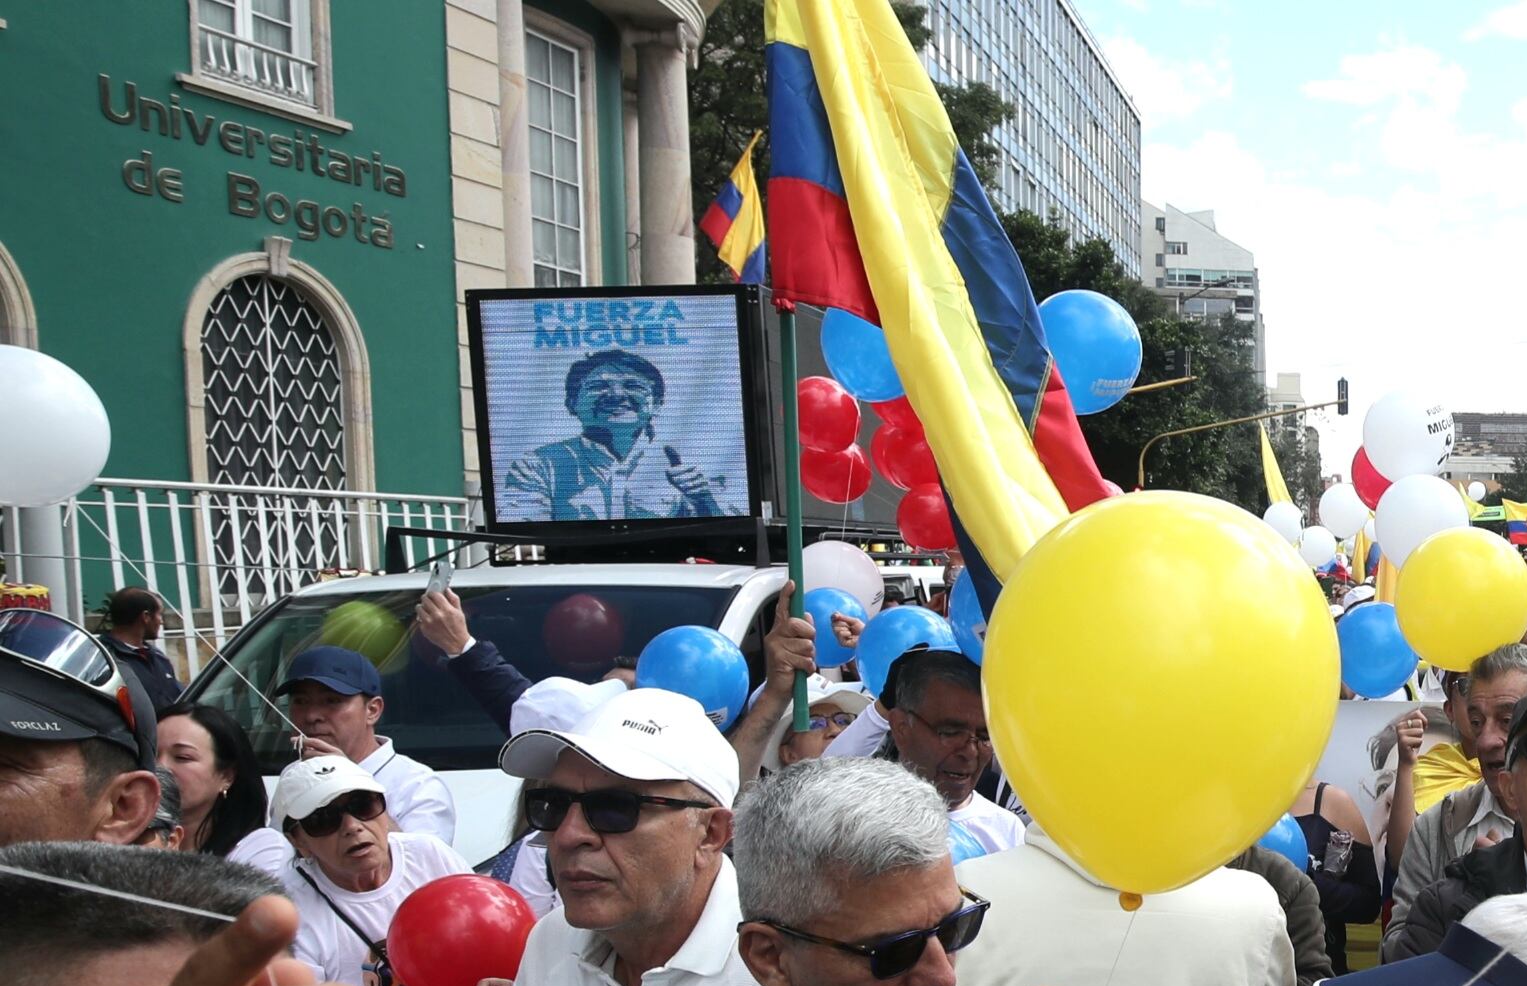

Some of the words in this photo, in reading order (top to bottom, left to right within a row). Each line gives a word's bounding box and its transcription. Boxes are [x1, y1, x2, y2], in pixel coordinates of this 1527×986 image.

[99, 73, 406, 197] Universitaria
[122, 150, 184, 203] de
[533, 300, 685, 323] FUERZA
[534, 323, 689, 347] MIGUEL
[10, 720, 61, 731] FORCLAZ
[622, 719, 656, 735] PUMA
